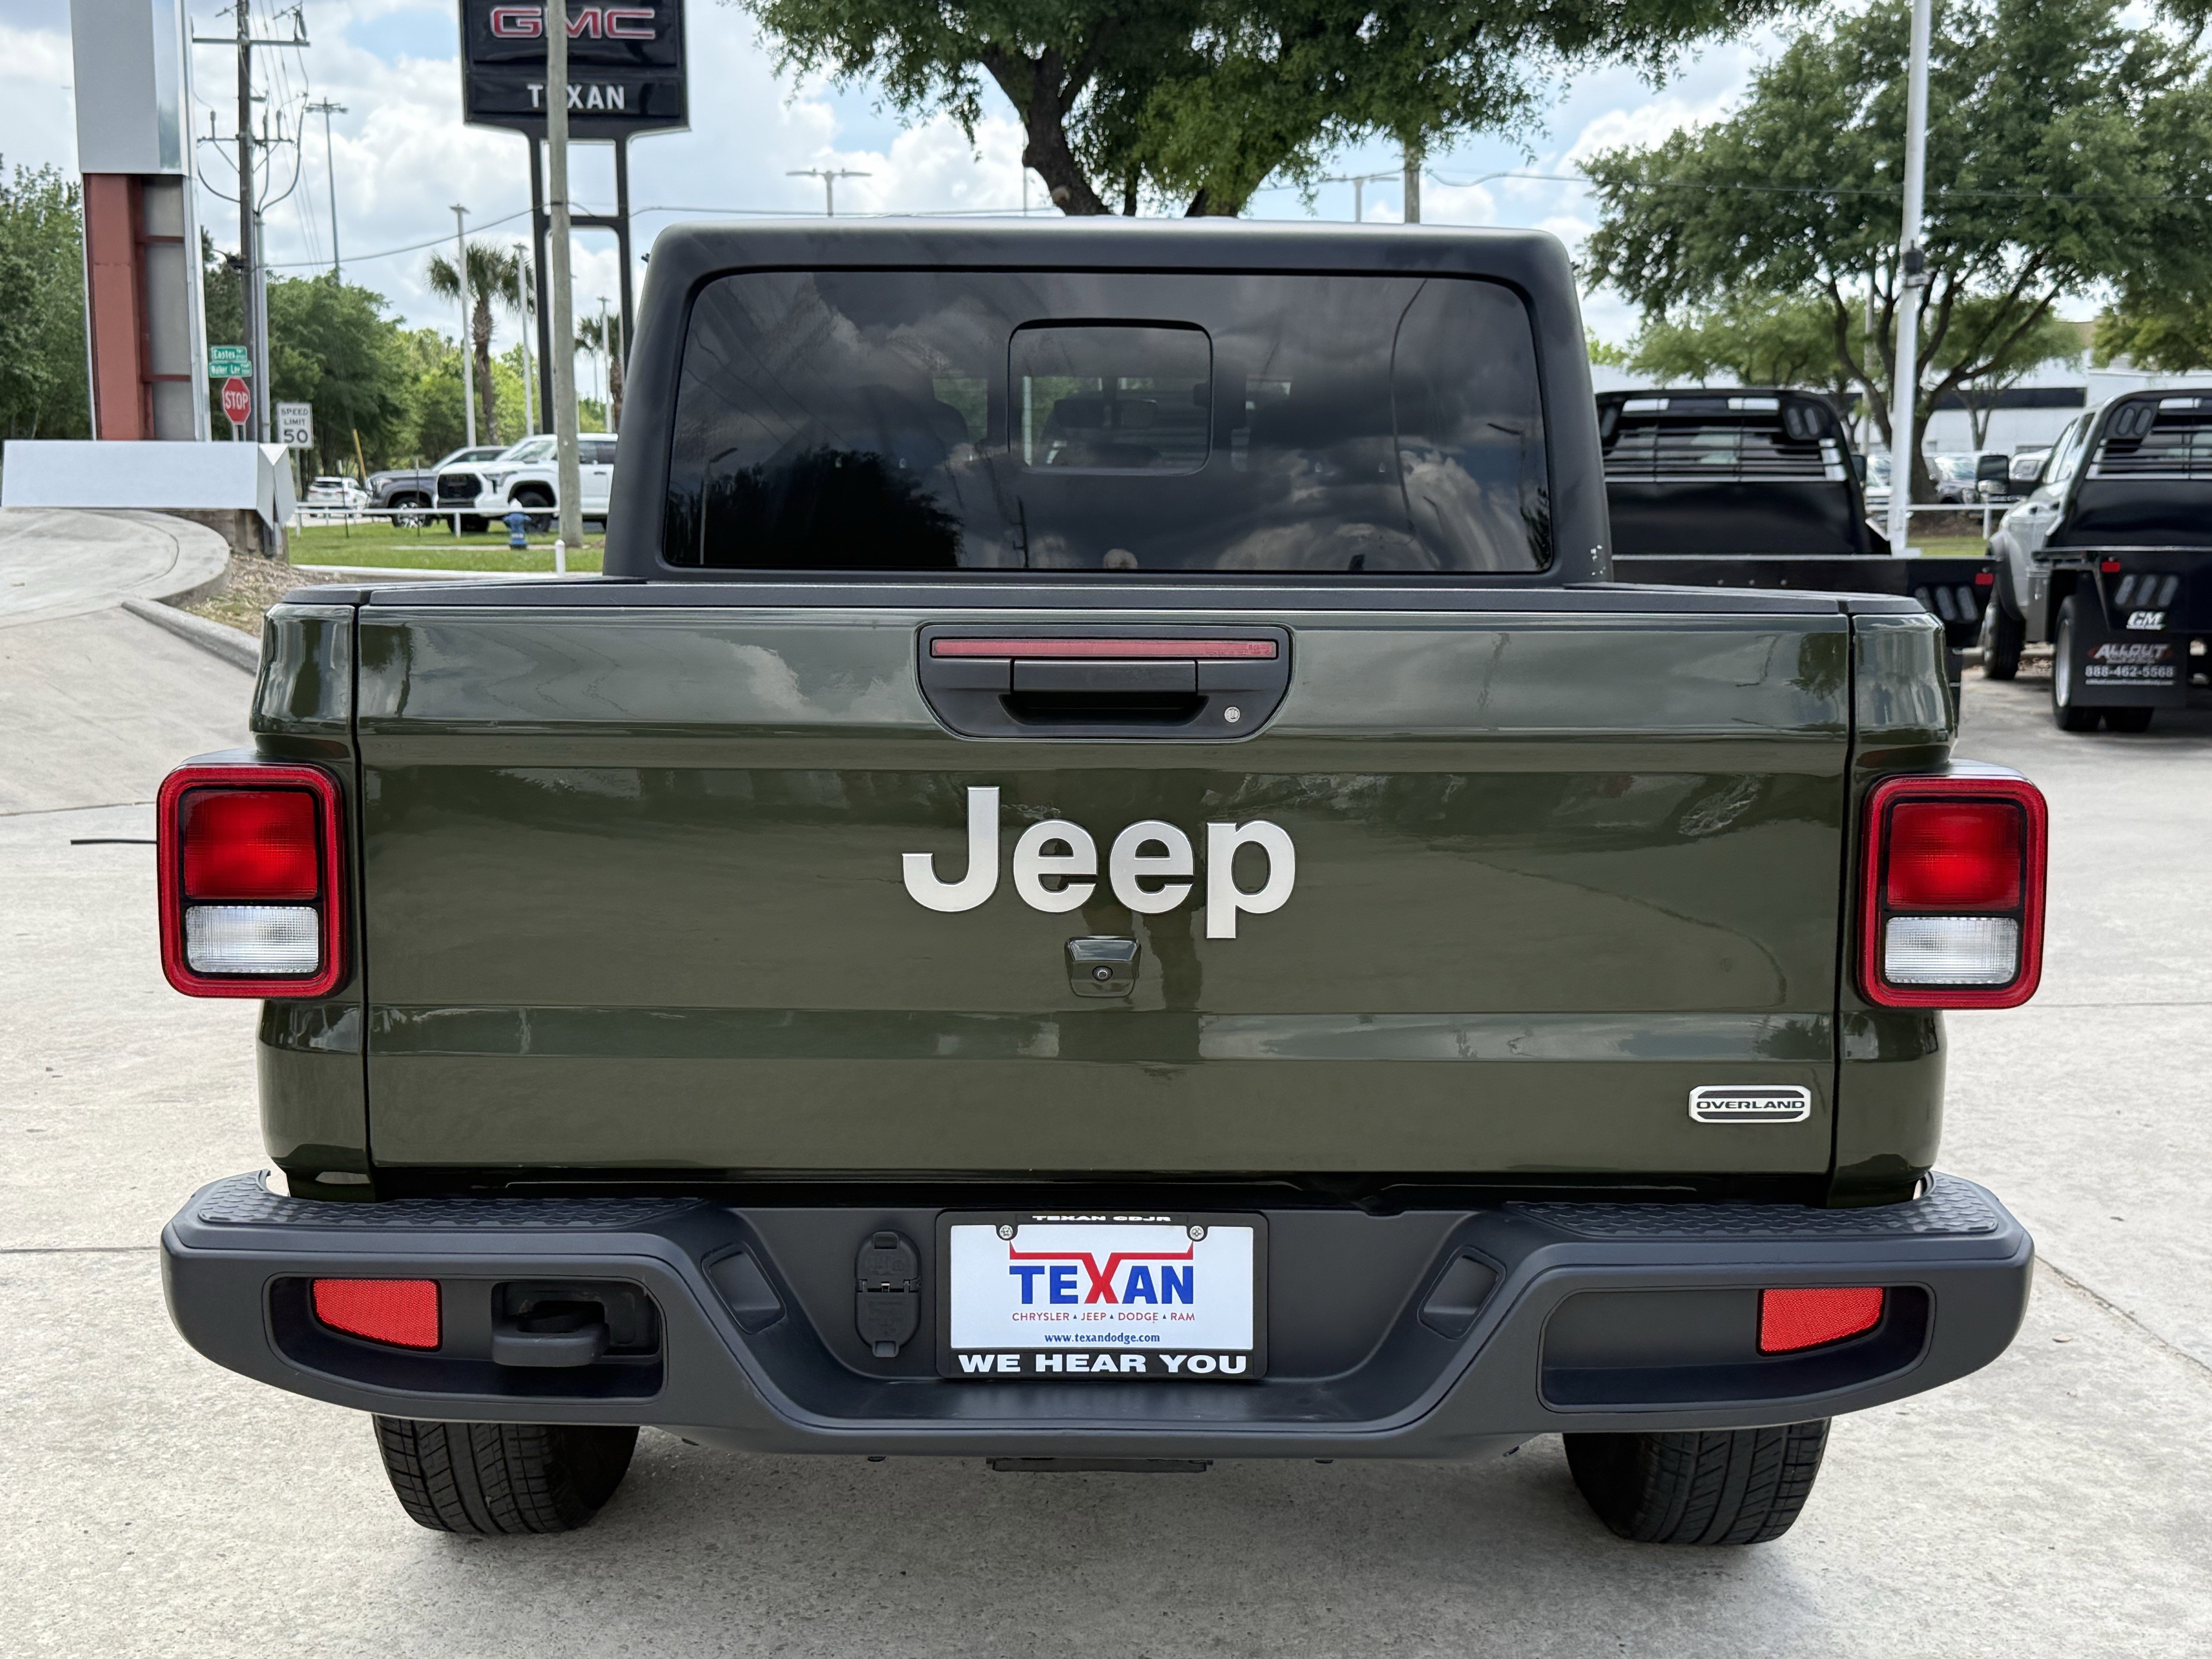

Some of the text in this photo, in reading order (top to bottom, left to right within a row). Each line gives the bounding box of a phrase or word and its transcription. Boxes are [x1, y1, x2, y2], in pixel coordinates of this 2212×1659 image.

[490, 7, 655, 39] GMC
[527, 84, 625, 110] TXAN
[225, 390, 249, 410] STOP
[281, 408, 309, 416] SPEED
[284, 429, 309, 444] 50
[902, 786, 1295, 938] Jeep
[1696, 1100, 1805, 1109] OVERLAND
[1009, 1253, 1193, 1304] TEXAN
[1012, 1312, 1195, 1321] CHRYSLER JEEP DODGE RAM
[1044, 1332, 1160, 1345] www.texandodge.com
[958, 1354, 1247, 1374] WE HEAR YOU
